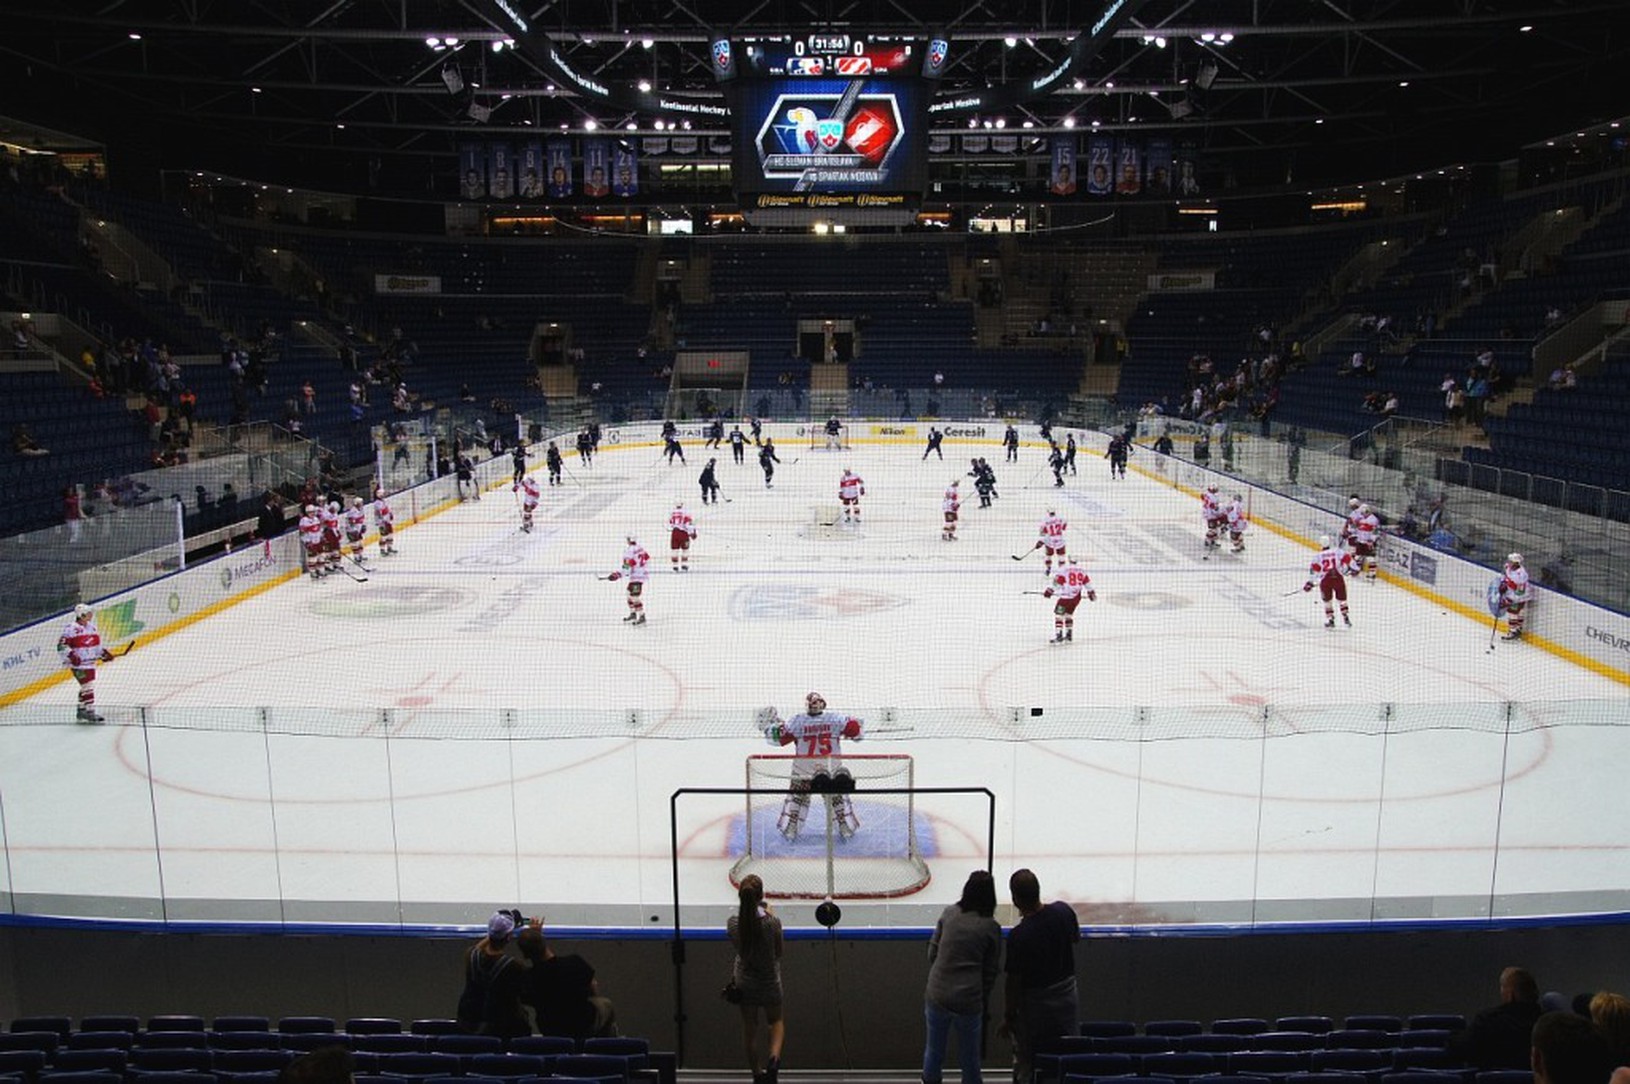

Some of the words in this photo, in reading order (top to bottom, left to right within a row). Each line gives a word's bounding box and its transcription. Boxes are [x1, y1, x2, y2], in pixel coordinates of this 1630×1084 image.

[795, 41, 805, 56] 0
[854, 41, 864, 56] 0
[1057, 148, 1071, 165] 15
[1092, 148, 1109, 165] 22
[1122, 148, 1136, 165] 21
[880, 427, 905, 436] Nikon
[944, 426, 986, 438] Ceresit
[803, 733, 832, 757] 75
